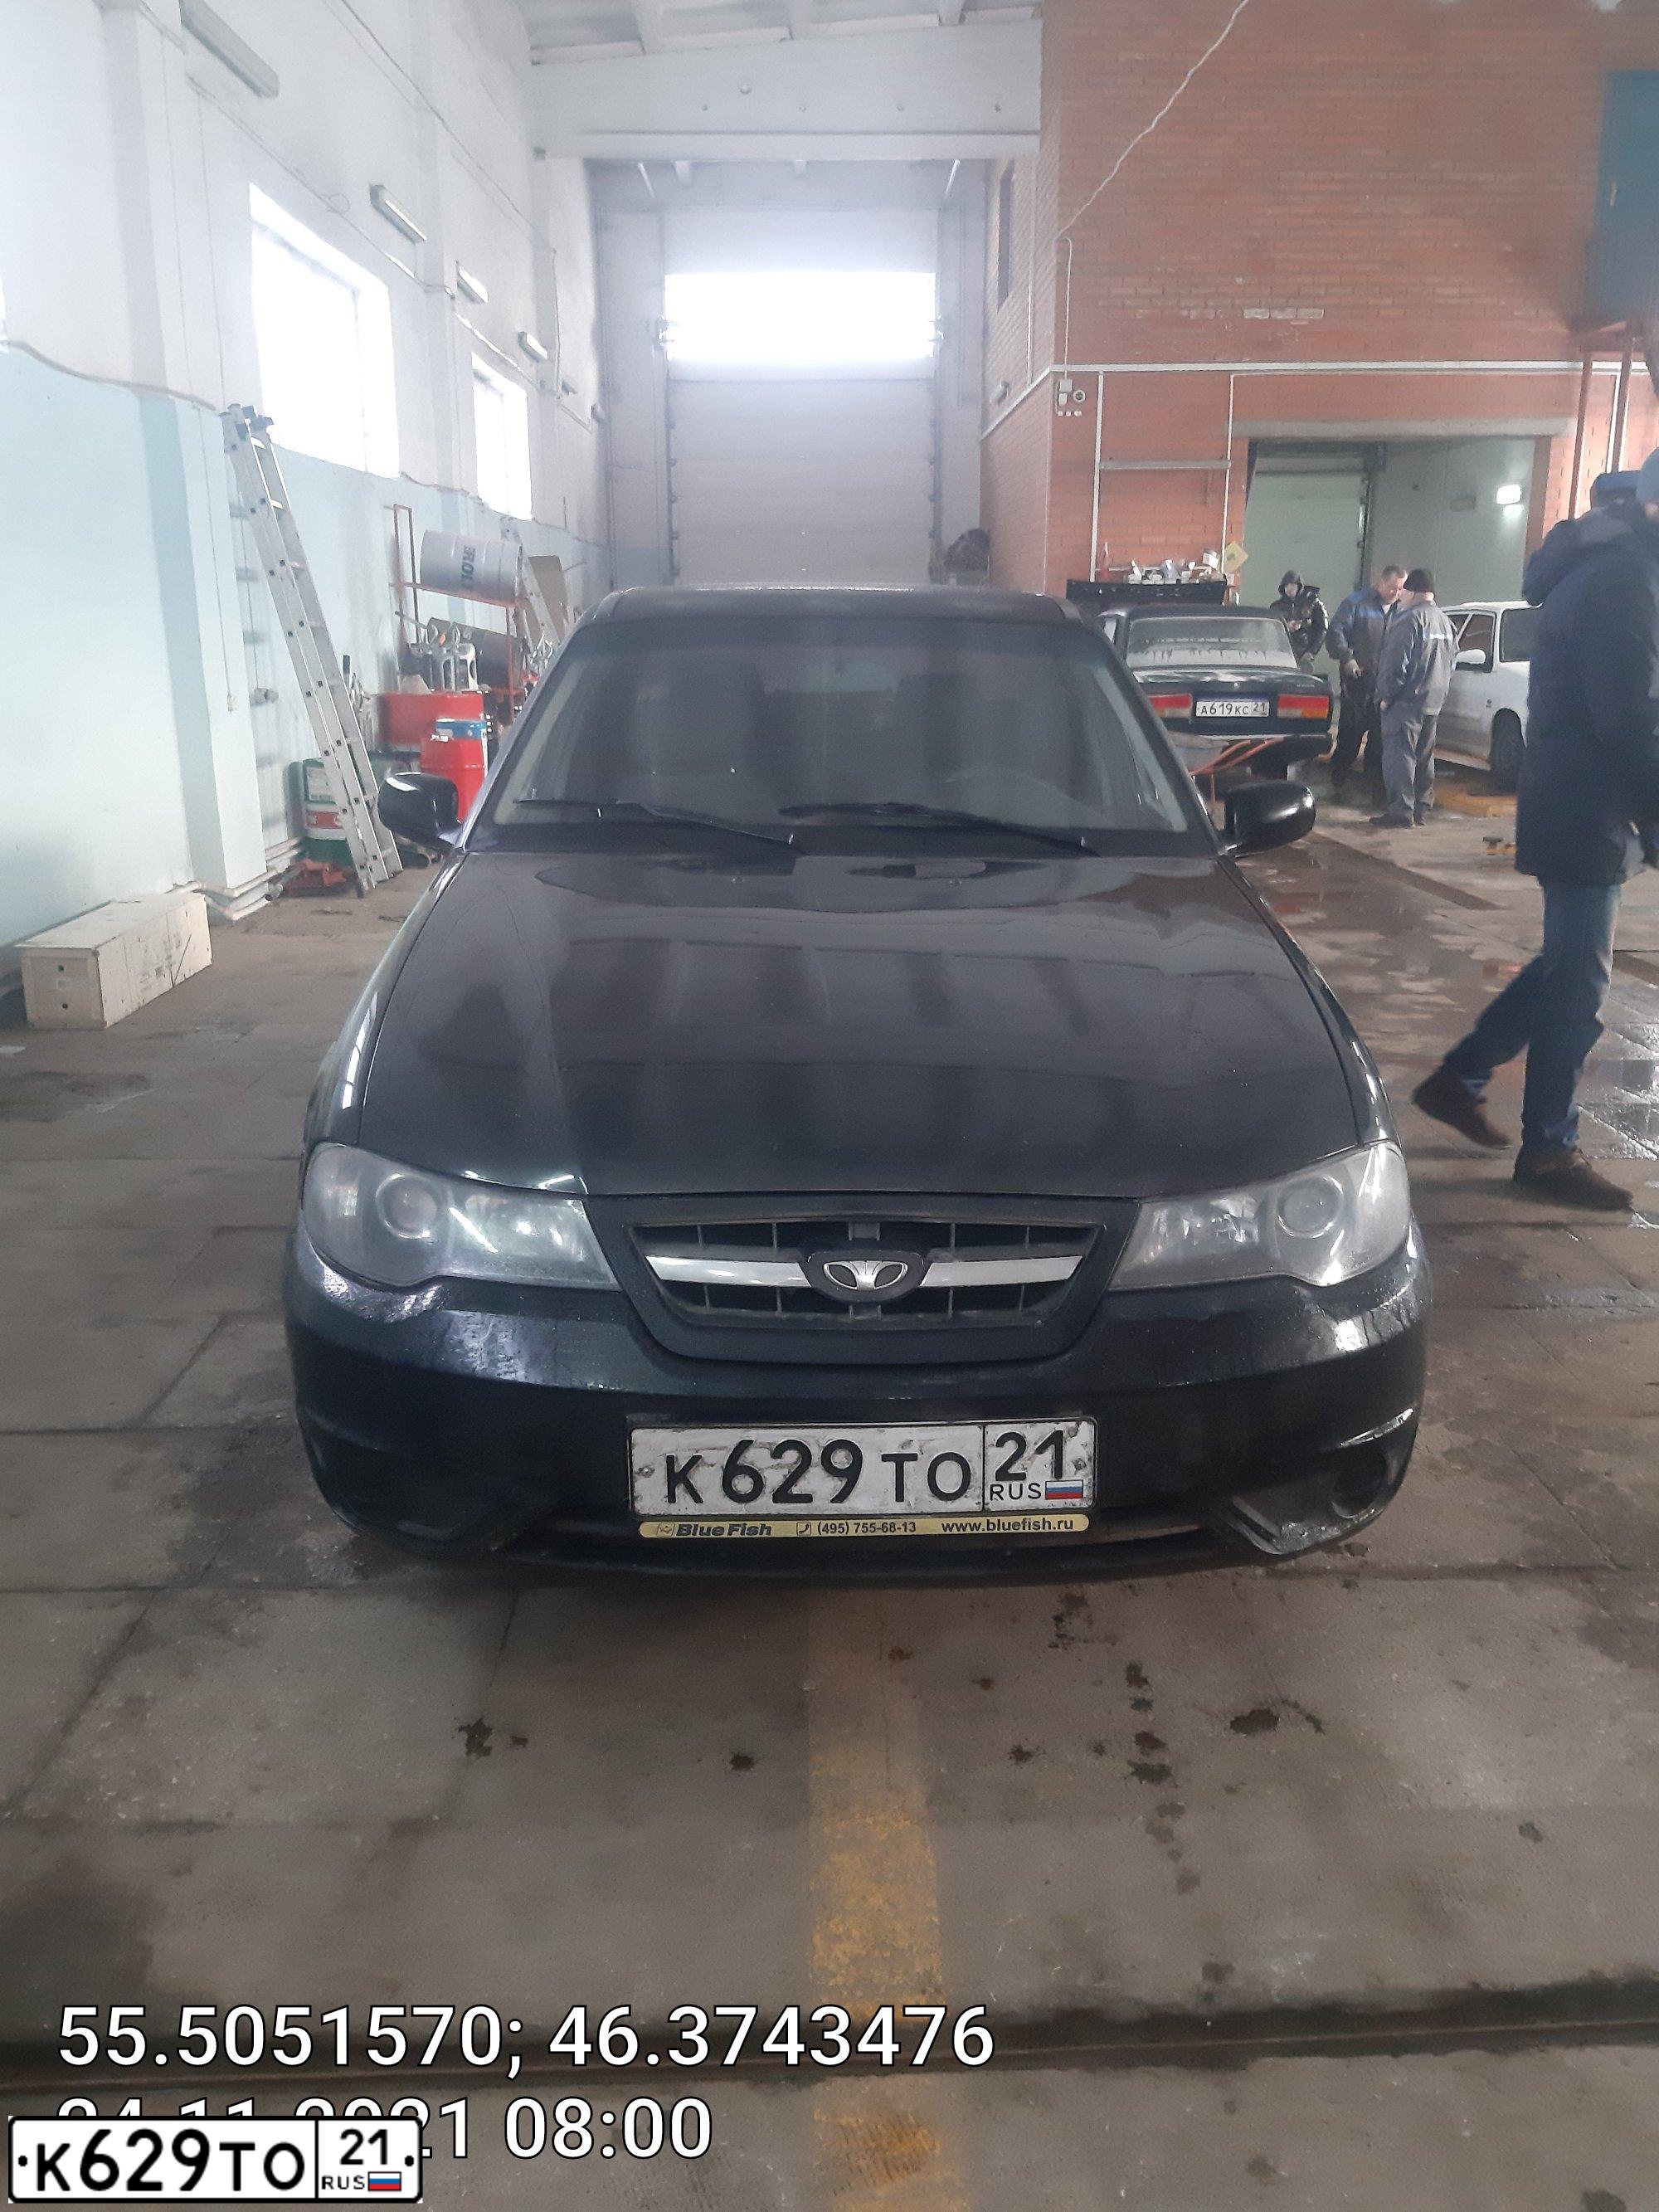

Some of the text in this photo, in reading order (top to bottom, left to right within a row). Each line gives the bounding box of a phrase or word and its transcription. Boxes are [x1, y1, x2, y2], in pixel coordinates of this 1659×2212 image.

[995, 1430, 1066, 1481] 21
[989, 1482, 1042, 1501] RUS
[676, 1517, 1074, 1537] Blue Fish (495) 755-68-13 www.bluefish.ru
